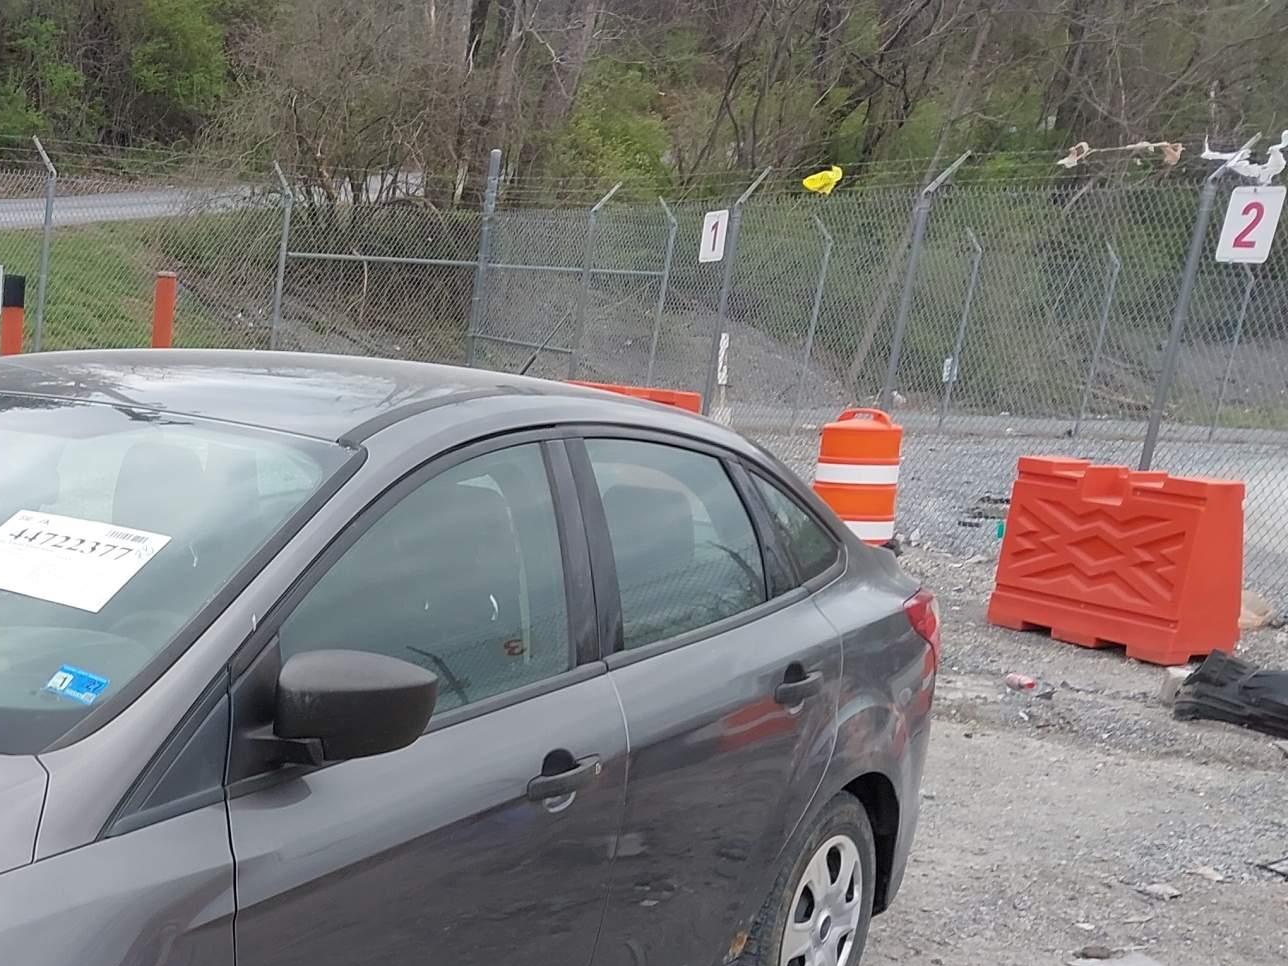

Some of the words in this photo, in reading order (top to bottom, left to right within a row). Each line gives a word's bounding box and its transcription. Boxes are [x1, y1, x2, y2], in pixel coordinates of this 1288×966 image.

[711, 220, 720, 252] 1
[1232, 201, 1265, 248] 2
[9, 528, 134, 560] 44722377
